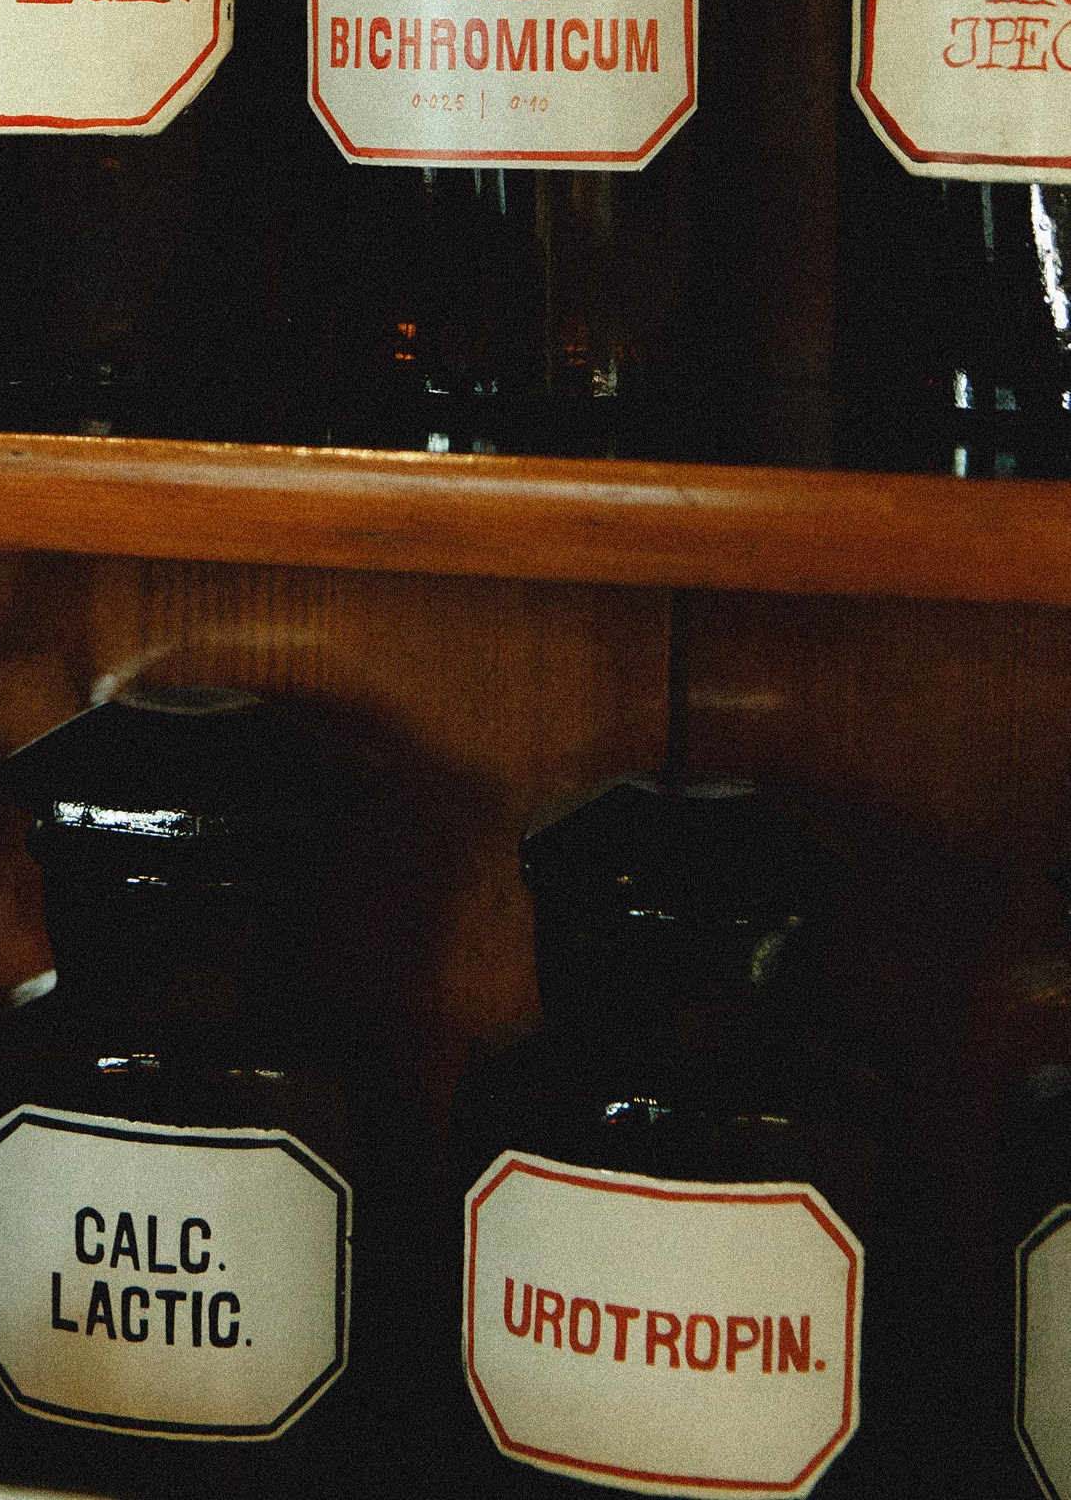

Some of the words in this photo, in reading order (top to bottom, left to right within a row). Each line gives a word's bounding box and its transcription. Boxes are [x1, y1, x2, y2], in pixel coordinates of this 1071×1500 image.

[330, 15, 660, 73] BICHROMICUM
[73, 1206, 227, 1275] CALC.
[50, 1271, 253, 1349] LACTIC.
[503, 1276, 828, 1375] UROTROPIN.
